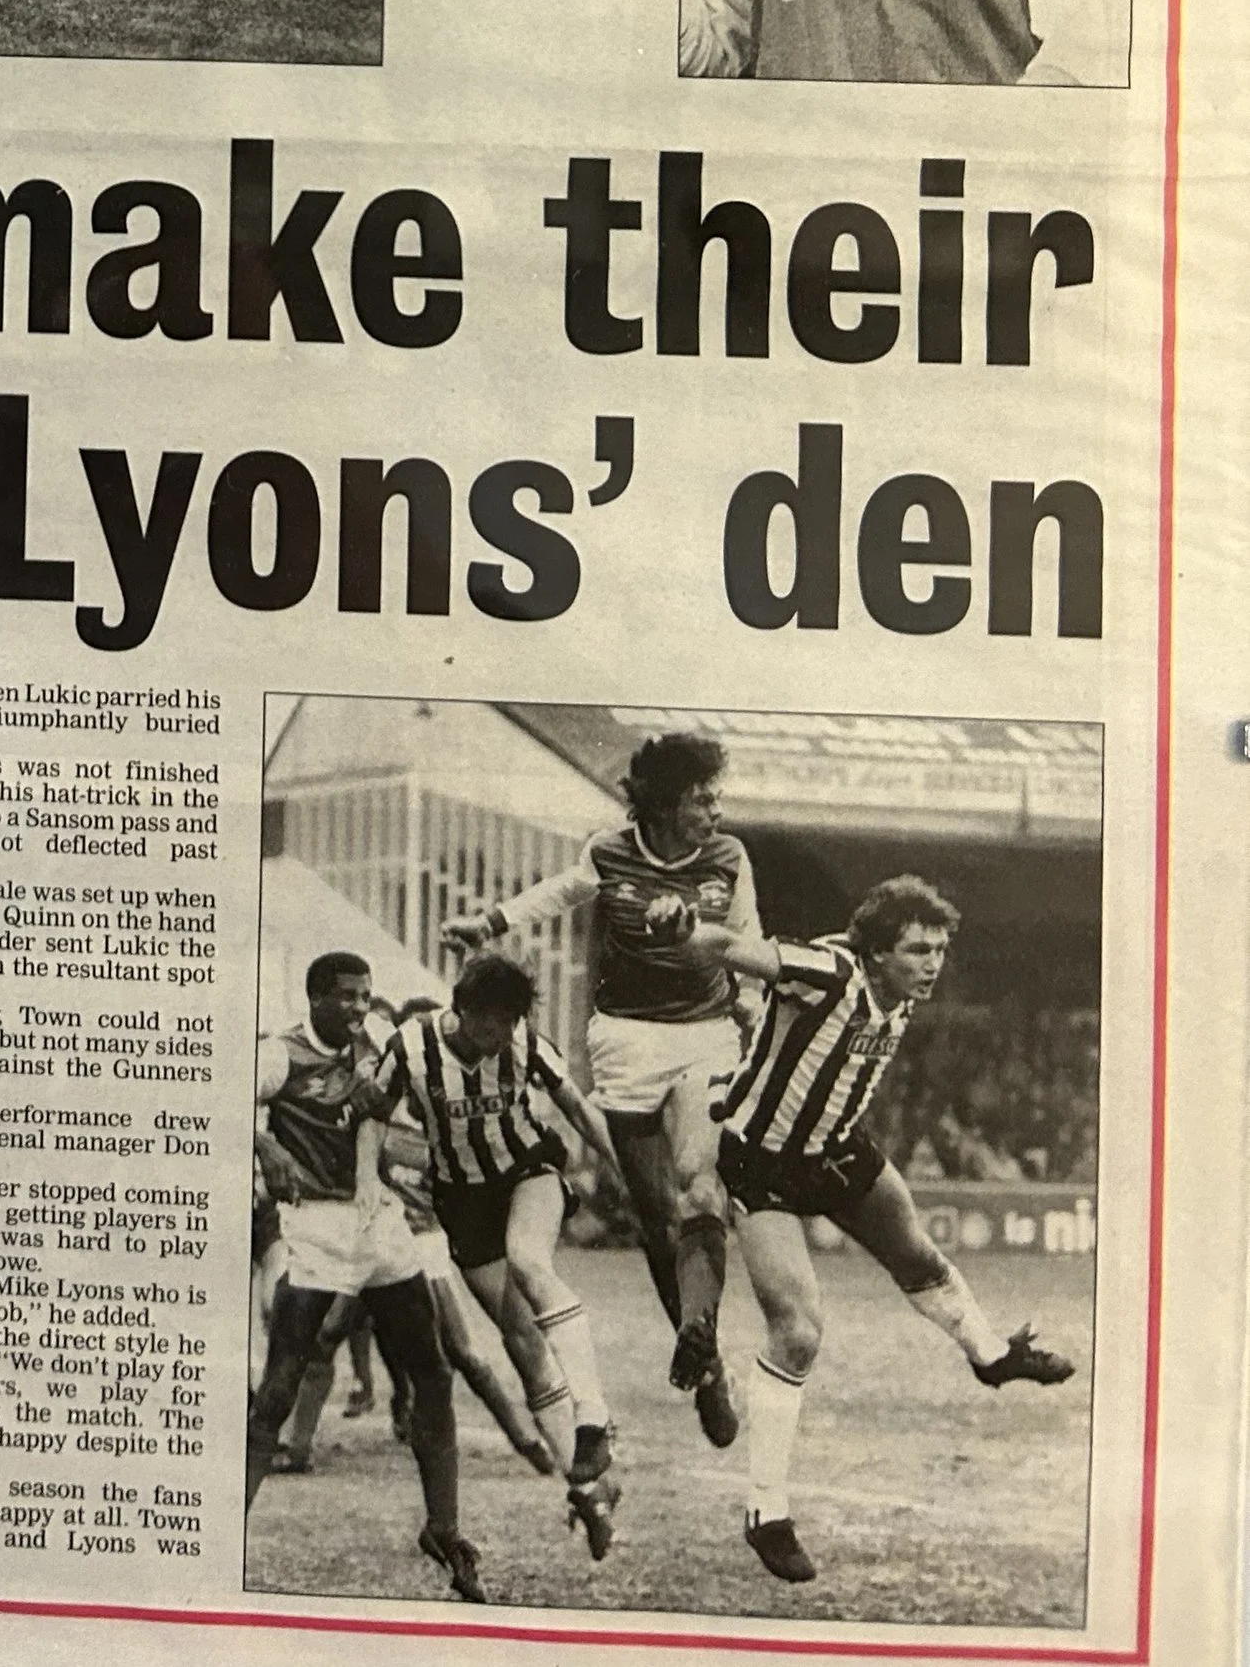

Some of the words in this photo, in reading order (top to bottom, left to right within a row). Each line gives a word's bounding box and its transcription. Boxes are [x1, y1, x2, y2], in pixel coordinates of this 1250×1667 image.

[543, 151, 1095, 367] their
[723, 423, 1104, 639] den
[3, 1527, 47, 1550] and
[66, 1529, 136, 1556] Lyons
[156, 1537, 201, 1557] was
